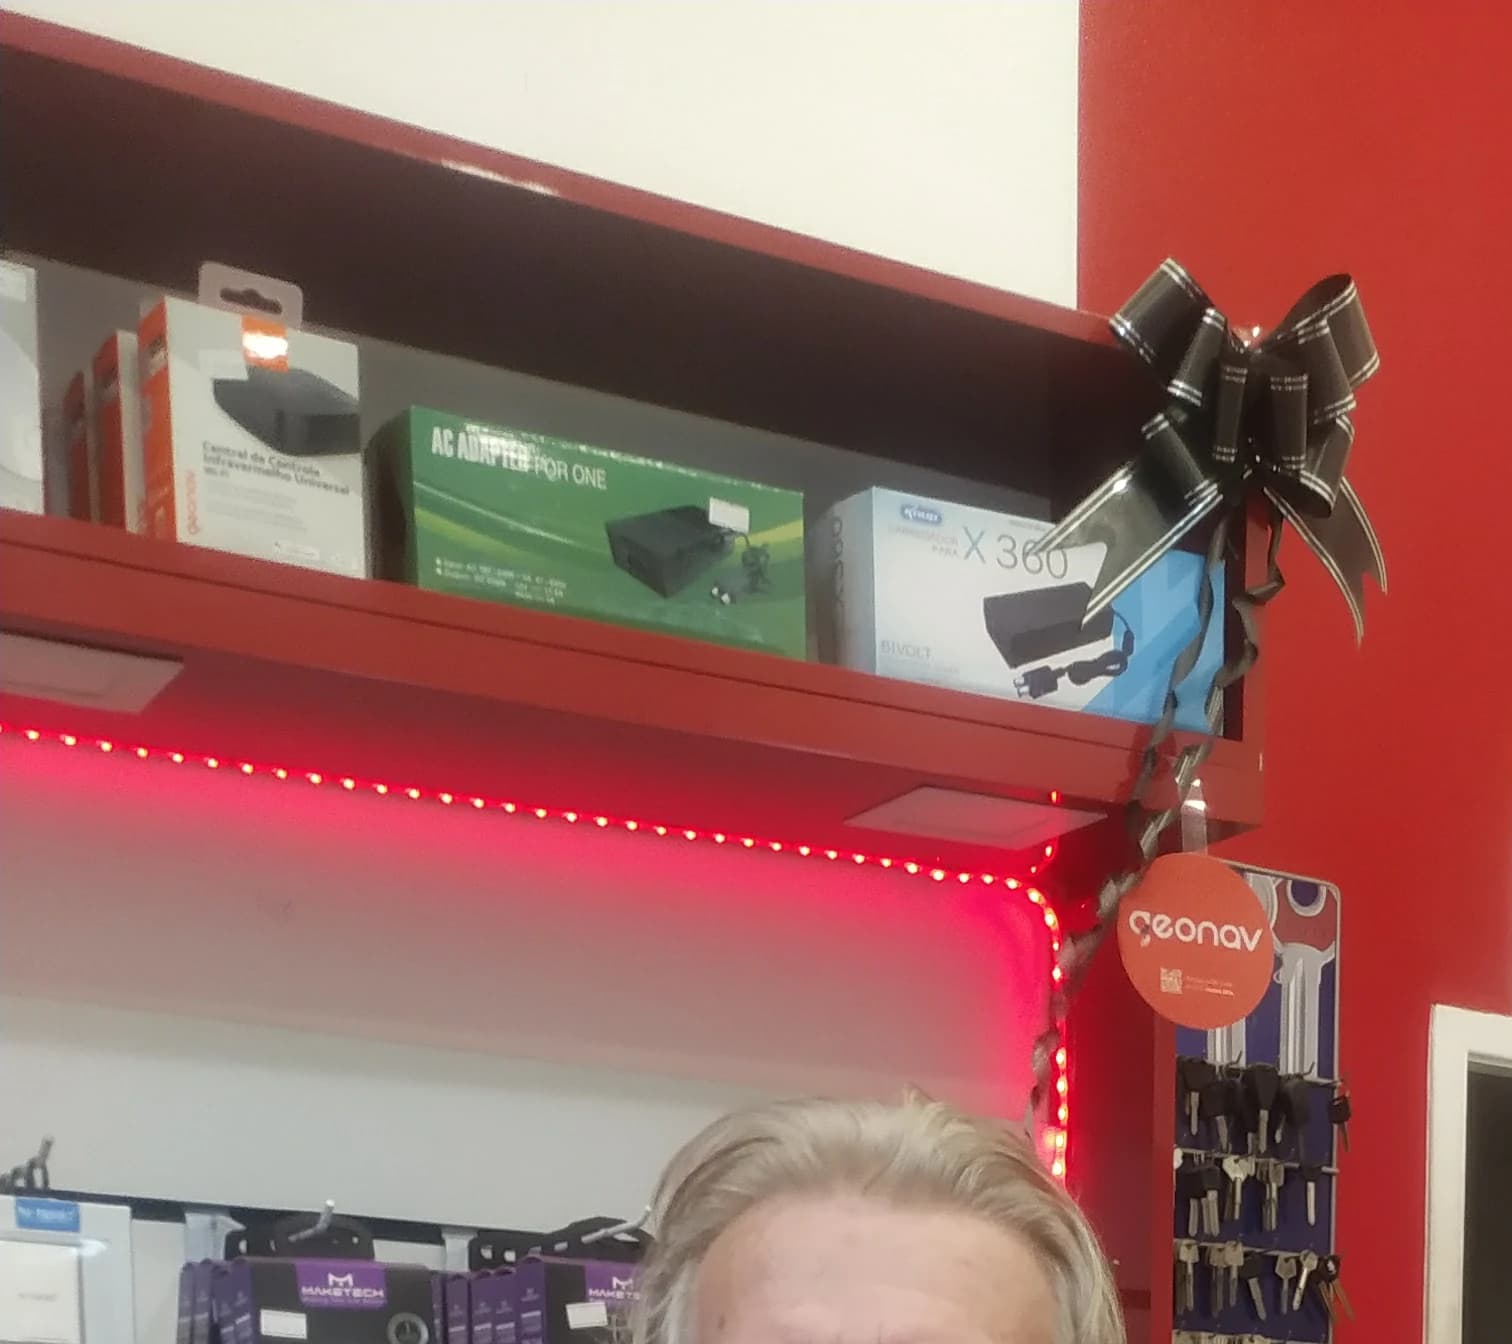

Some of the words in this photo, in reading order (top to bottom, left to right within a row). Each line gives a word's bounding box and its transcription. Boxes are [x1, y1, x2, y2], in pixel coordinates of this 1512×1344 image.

[432, 427, 453, 458] AC
[458, 432, 530, 472] ADAPTER
[572, 464, 607, 490] ONE
[1128, 909, 1263, 952] geonav
[301, 1286, 385, 1298] MAKETECH
